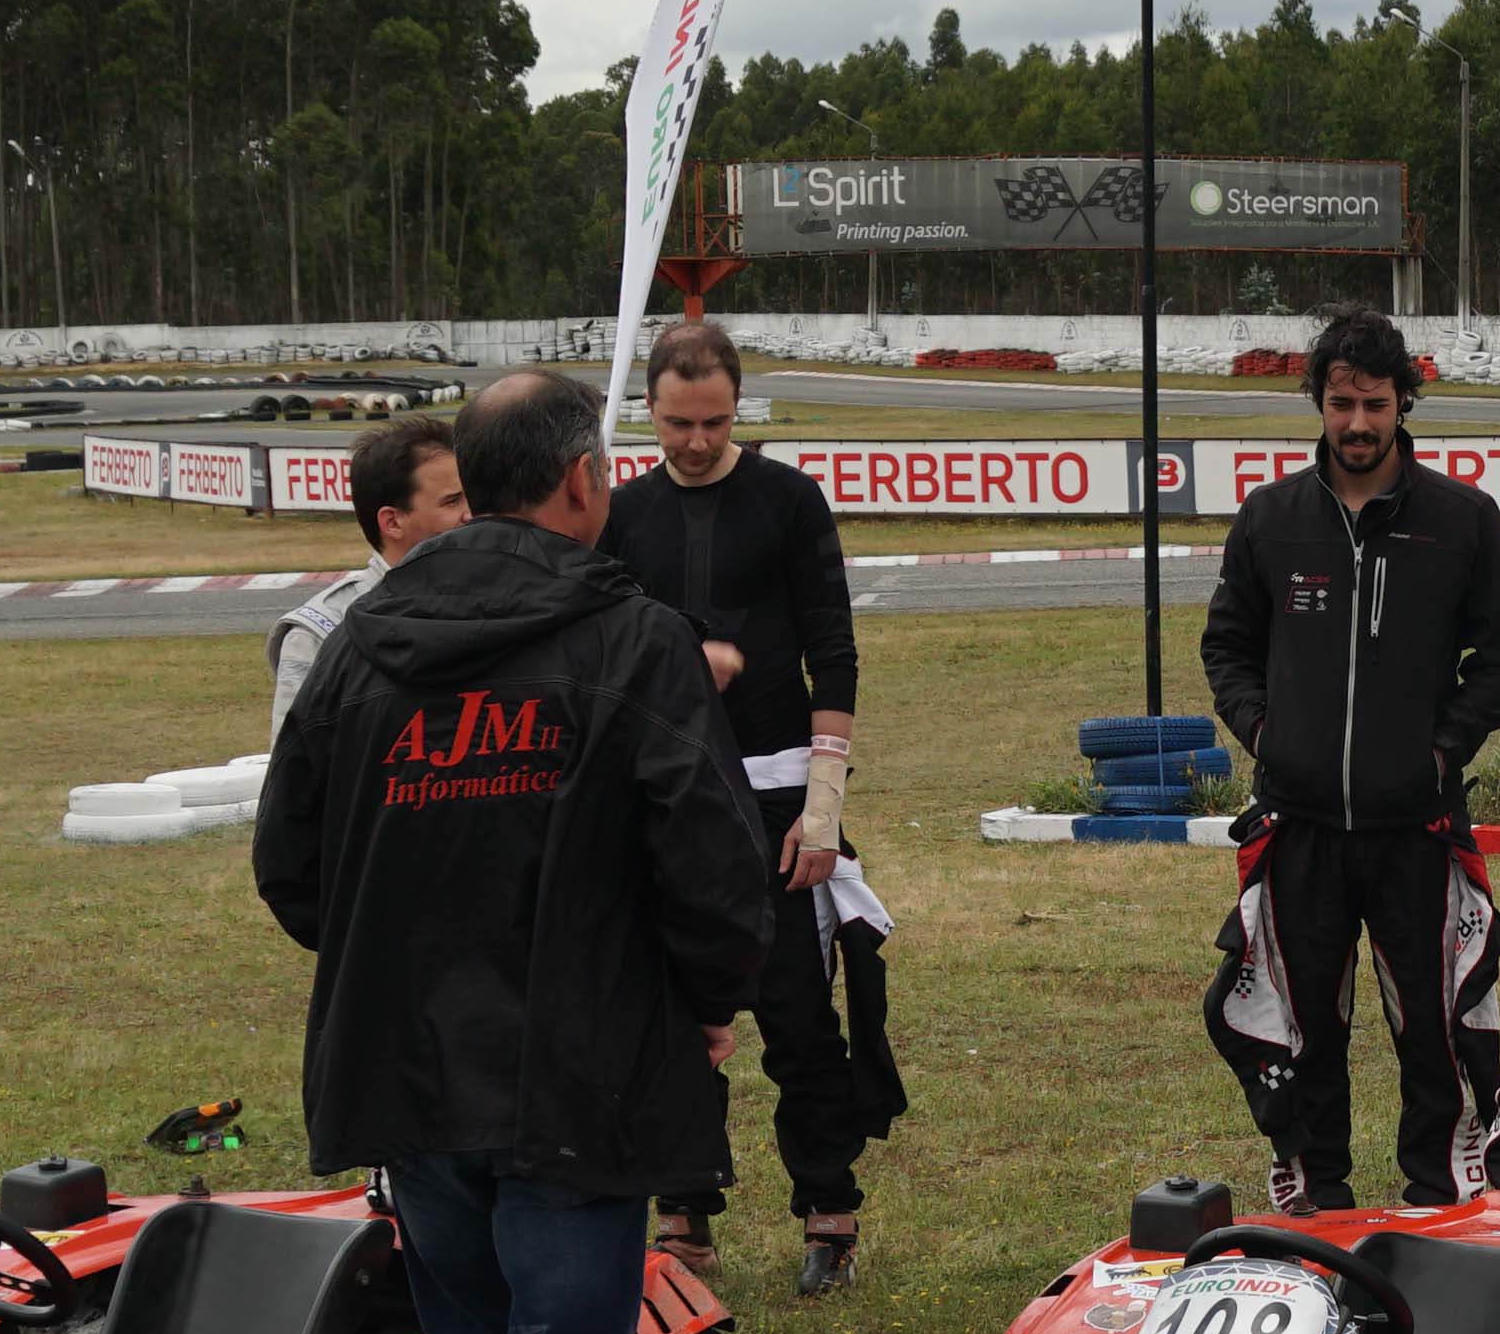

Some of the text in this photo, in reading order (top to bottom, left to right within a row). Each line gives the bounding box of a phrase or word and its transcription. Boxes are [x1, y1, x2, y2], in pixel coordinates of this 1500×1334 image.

[808, 165, 907, 216] Spirit
[1226, 187, 1380, 216] Steersman
[836, 222, 969, 244] Printing passion.
[91, 445, 152, 489] FERBERTO
[179, 452, 244, 499] FERBERTO
[798, 451, 1090, 504] FERBERTO
[383, 690, 543, 768] AJM
[1171, 1278, 1300, 1299] EUROINDY
